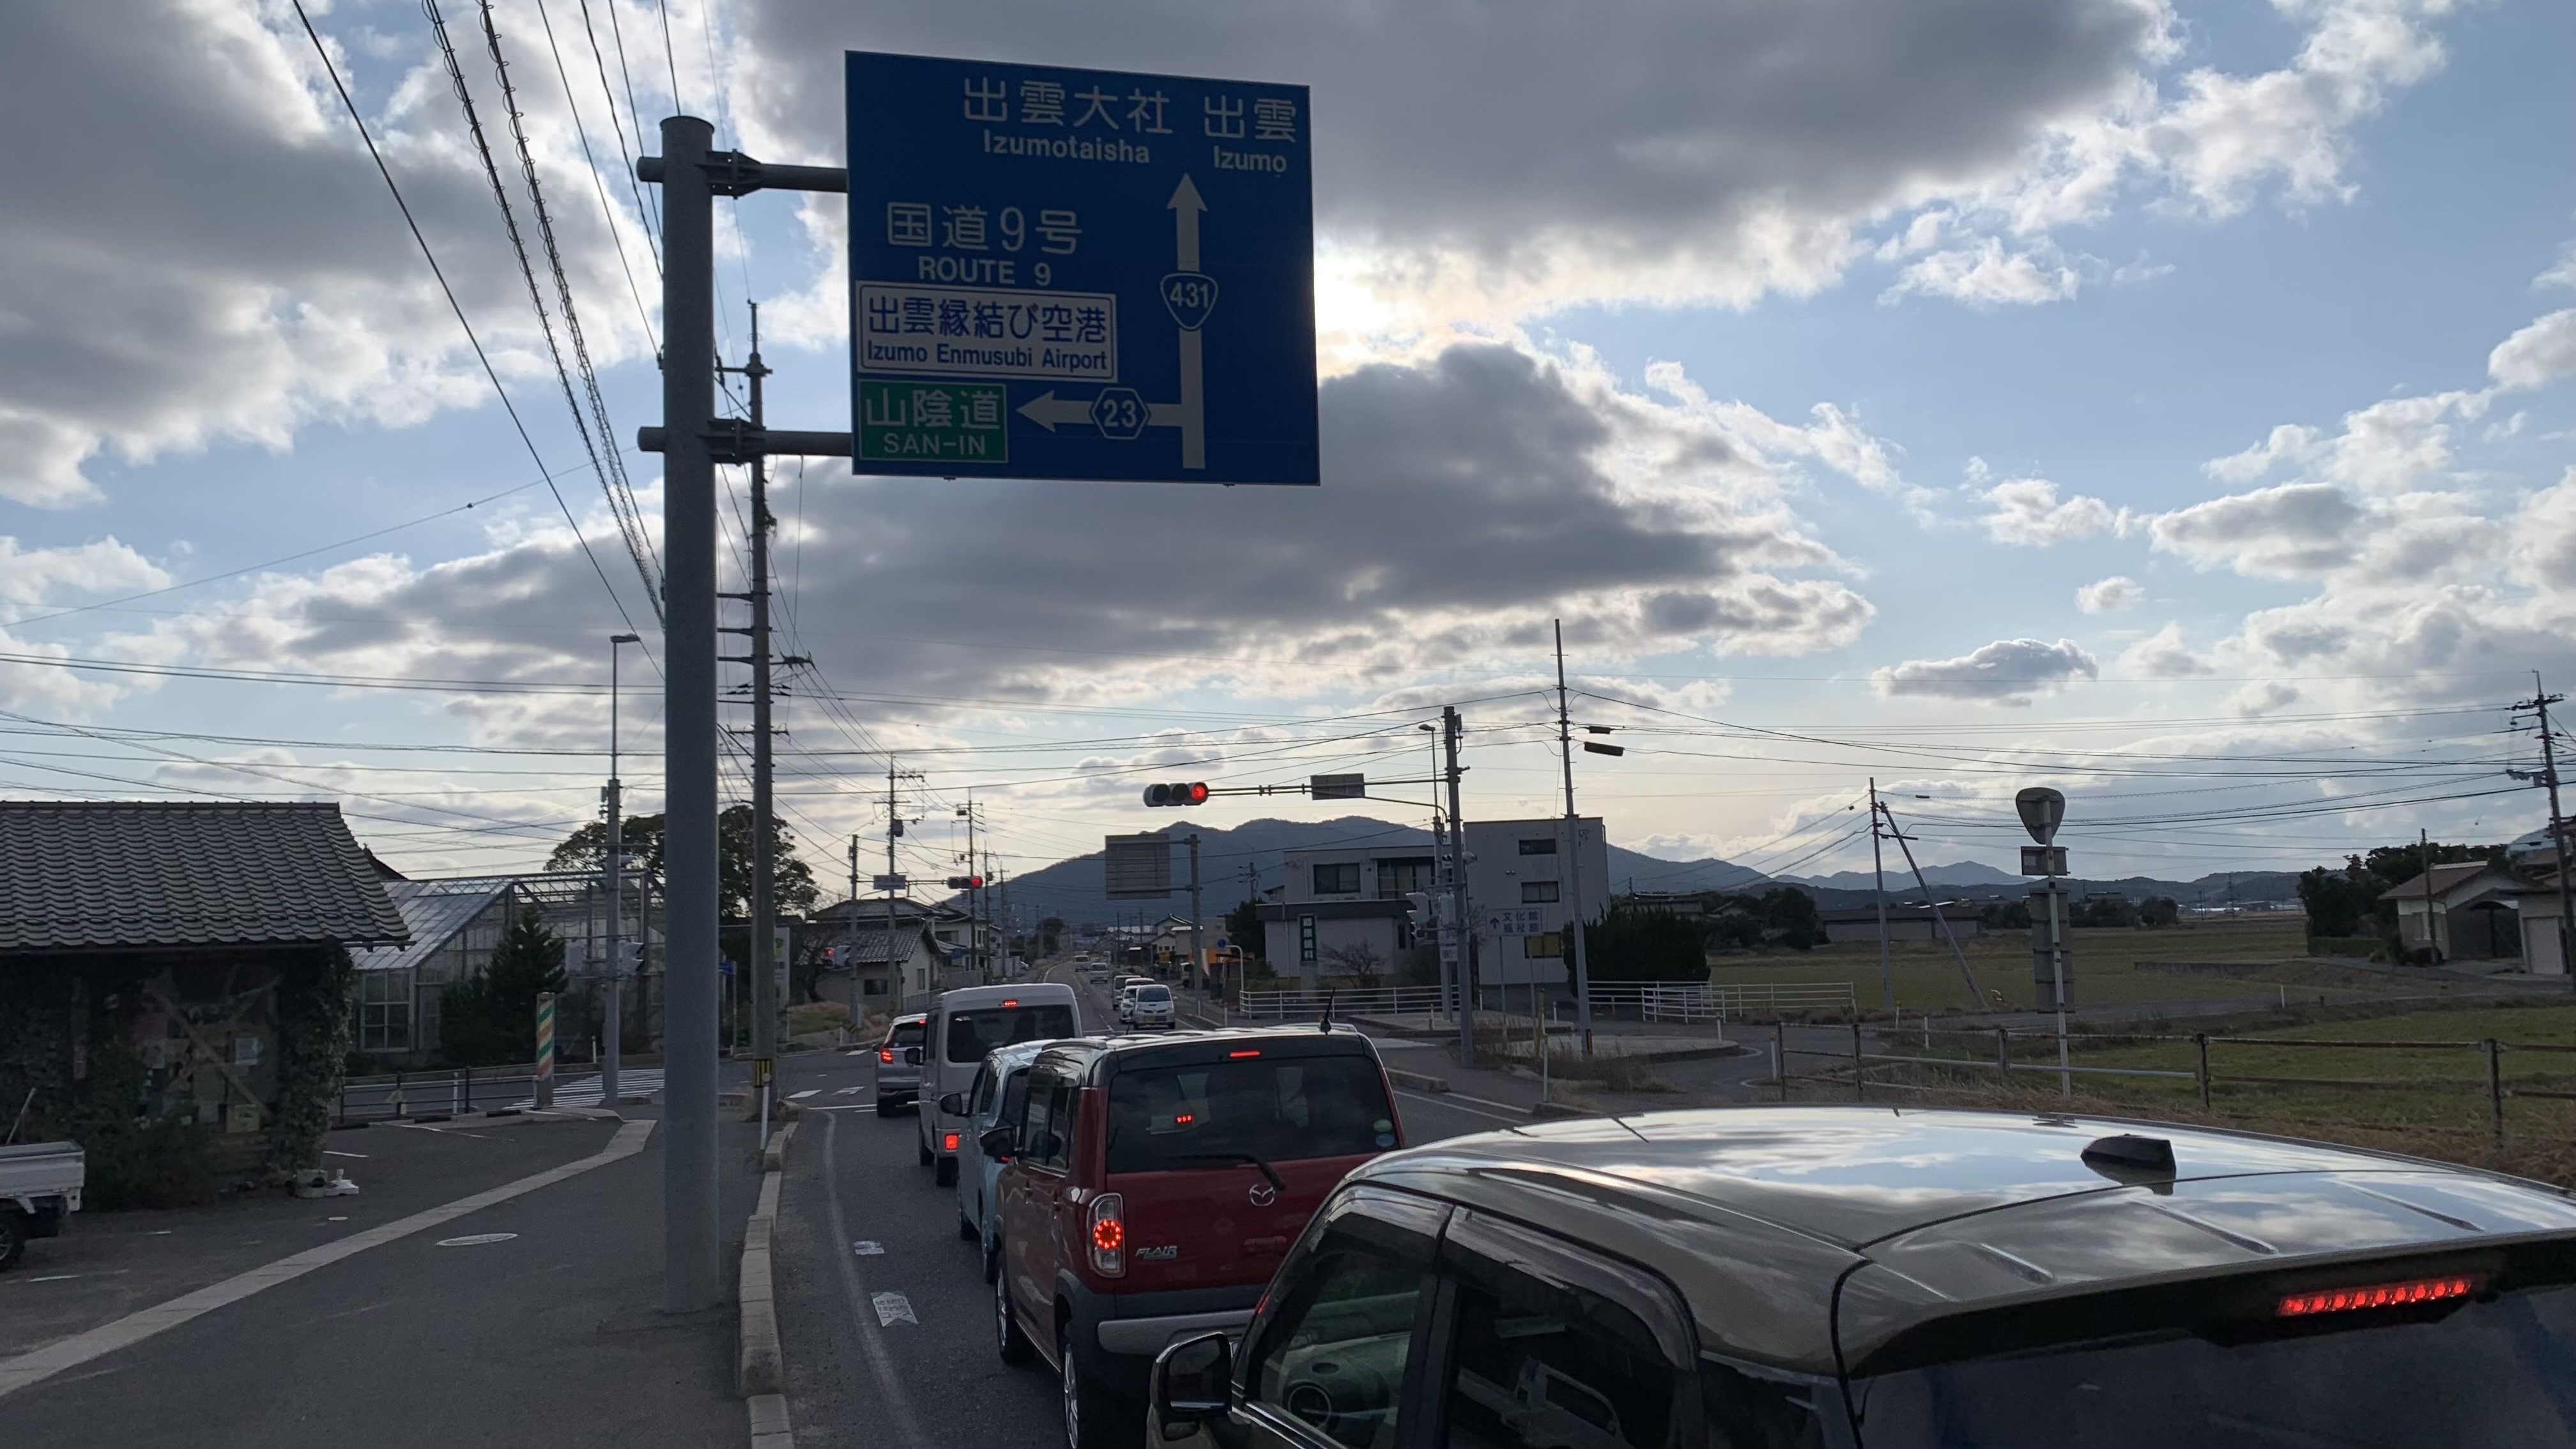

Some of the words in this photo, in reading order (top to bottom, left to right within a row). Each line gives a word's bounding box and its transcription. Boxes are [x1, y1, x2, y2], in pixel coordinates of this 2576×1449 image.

[964, 76, 1174, 135] 出雲大社
[1204, 95, 1297, 143] 出雲
[984, 130, 1150, 164] Izumotaisha
[1213, 150, 1287, 172] Izumo
[887, 201, 1083, 255] 国道9号
[918, 256, 1016, 285] ROUTE
[1034, 262, 1052, 286] 9
[1169, 282, 1209, 309] 431
[868, 296, 1107, 344] 出雲縁結び空港
[868, 340, 928, 362] Izumo
[937, 344, 1032, 368] Enmusubi
[1042, 348, 1107, 372] Airport
[866, 388, 1000, 430] 山陰道
[1103, 399, 1137, 428] 23
[884, 433, 986, 456] SAN-IN
